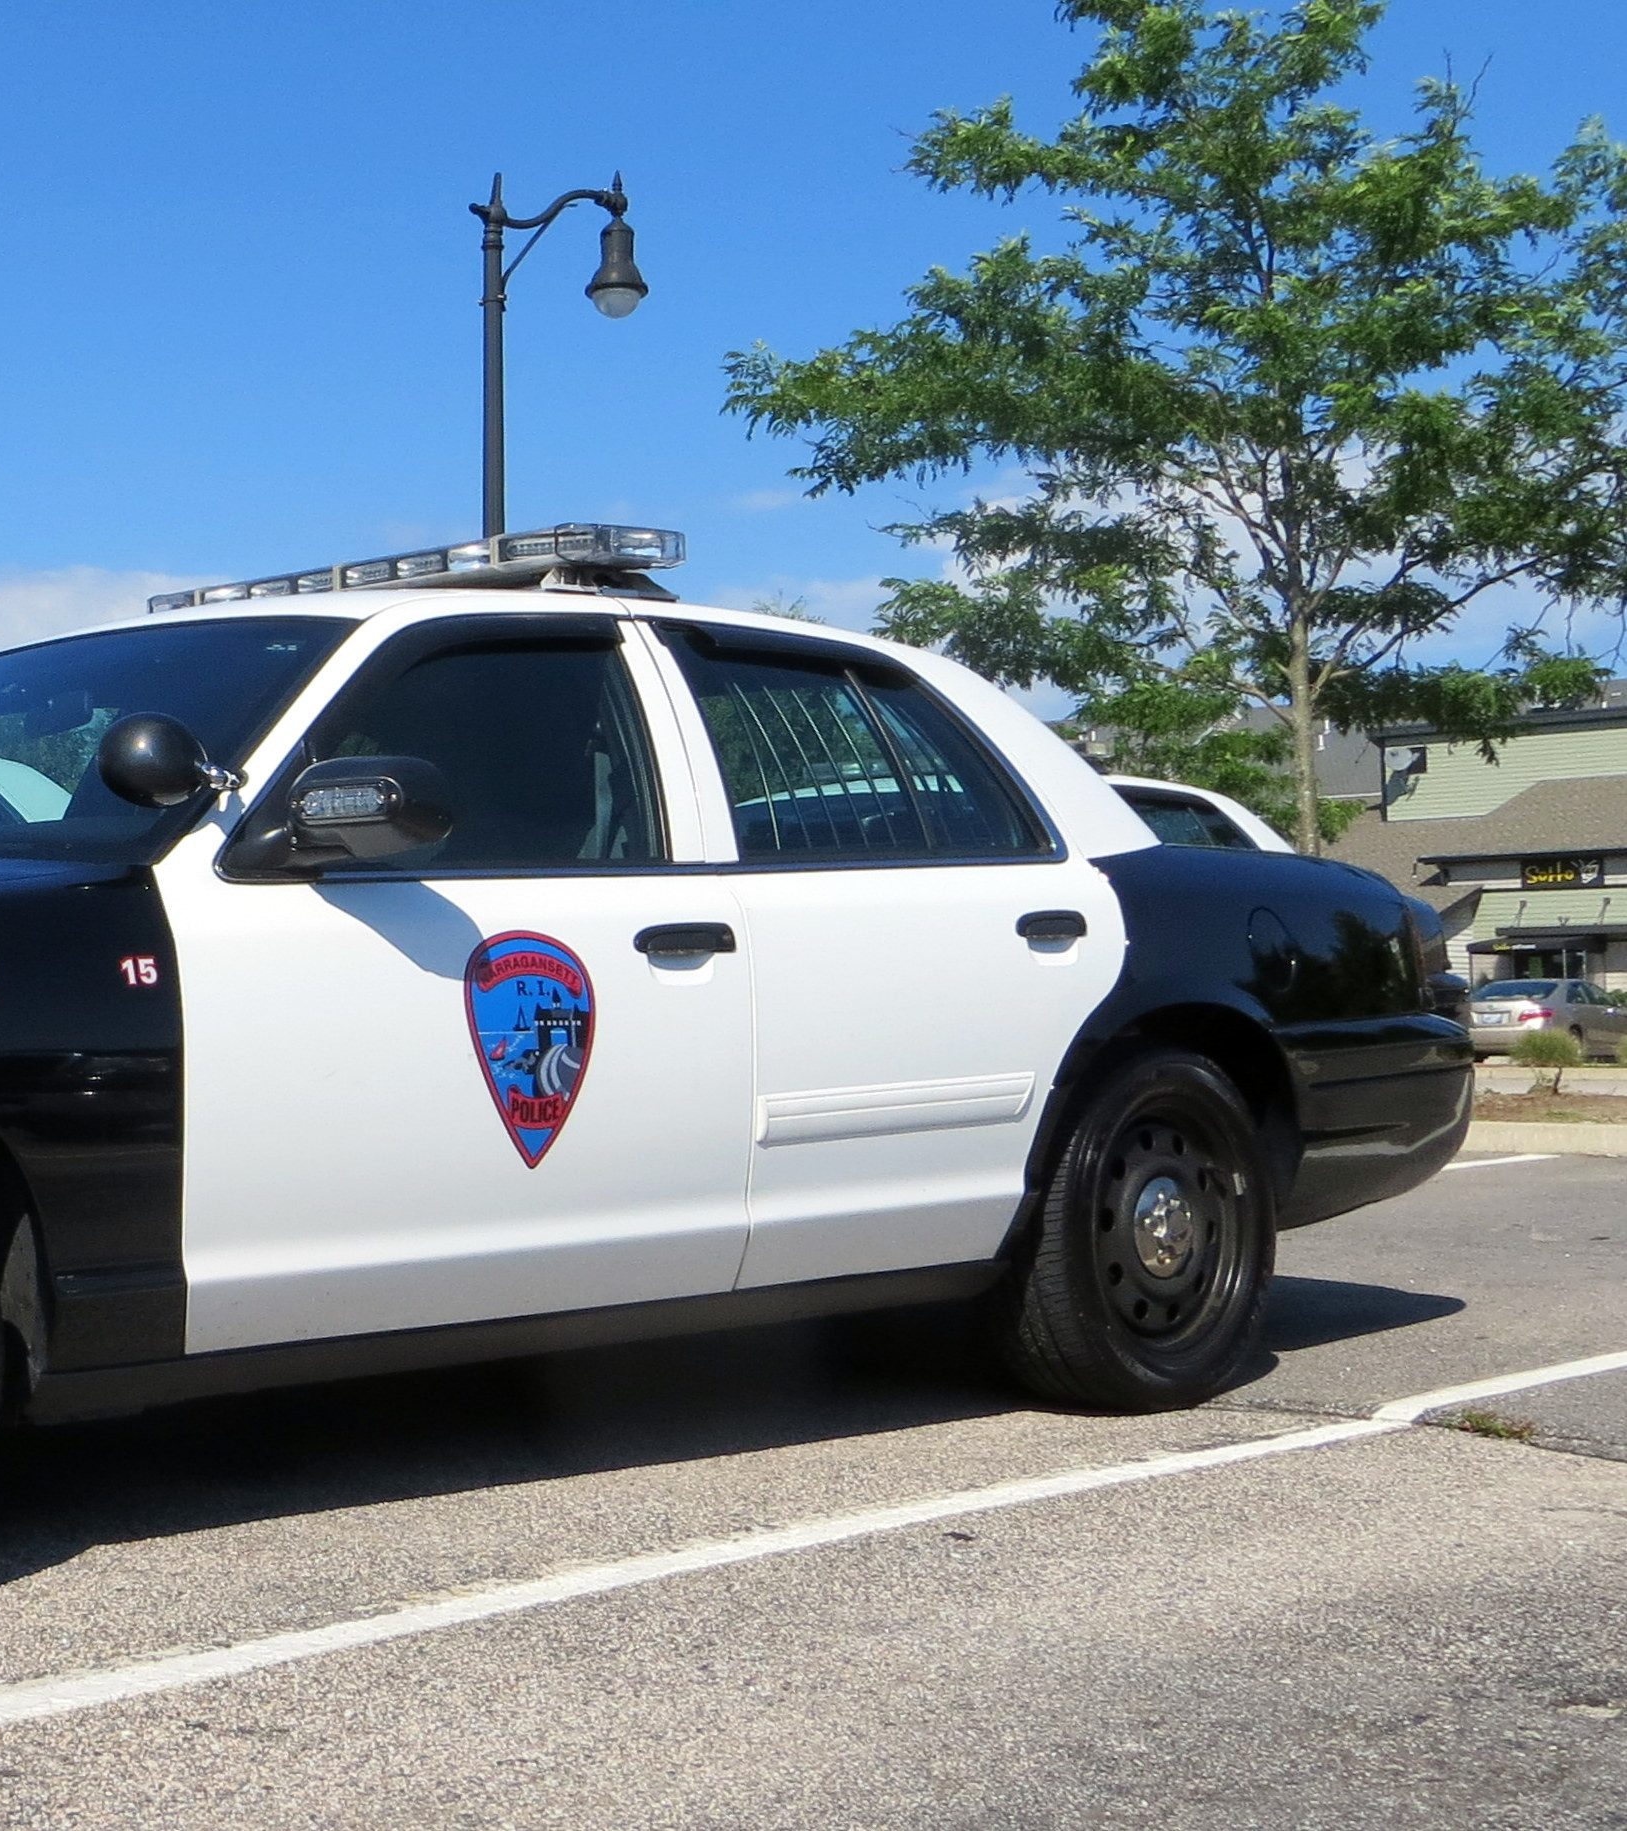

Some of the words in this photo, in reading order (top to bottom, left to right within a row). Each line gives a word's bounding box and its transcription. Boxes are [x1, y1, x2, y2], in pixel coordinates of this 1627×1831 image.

[120, 955, 158, 985] 15
[478, 955, 580, 988] NARRAGANSETT
[516, 980, 533, 997] R.
[538, 981, 551, 997] I.
[510, 1098, 560, 1124] POLICE
